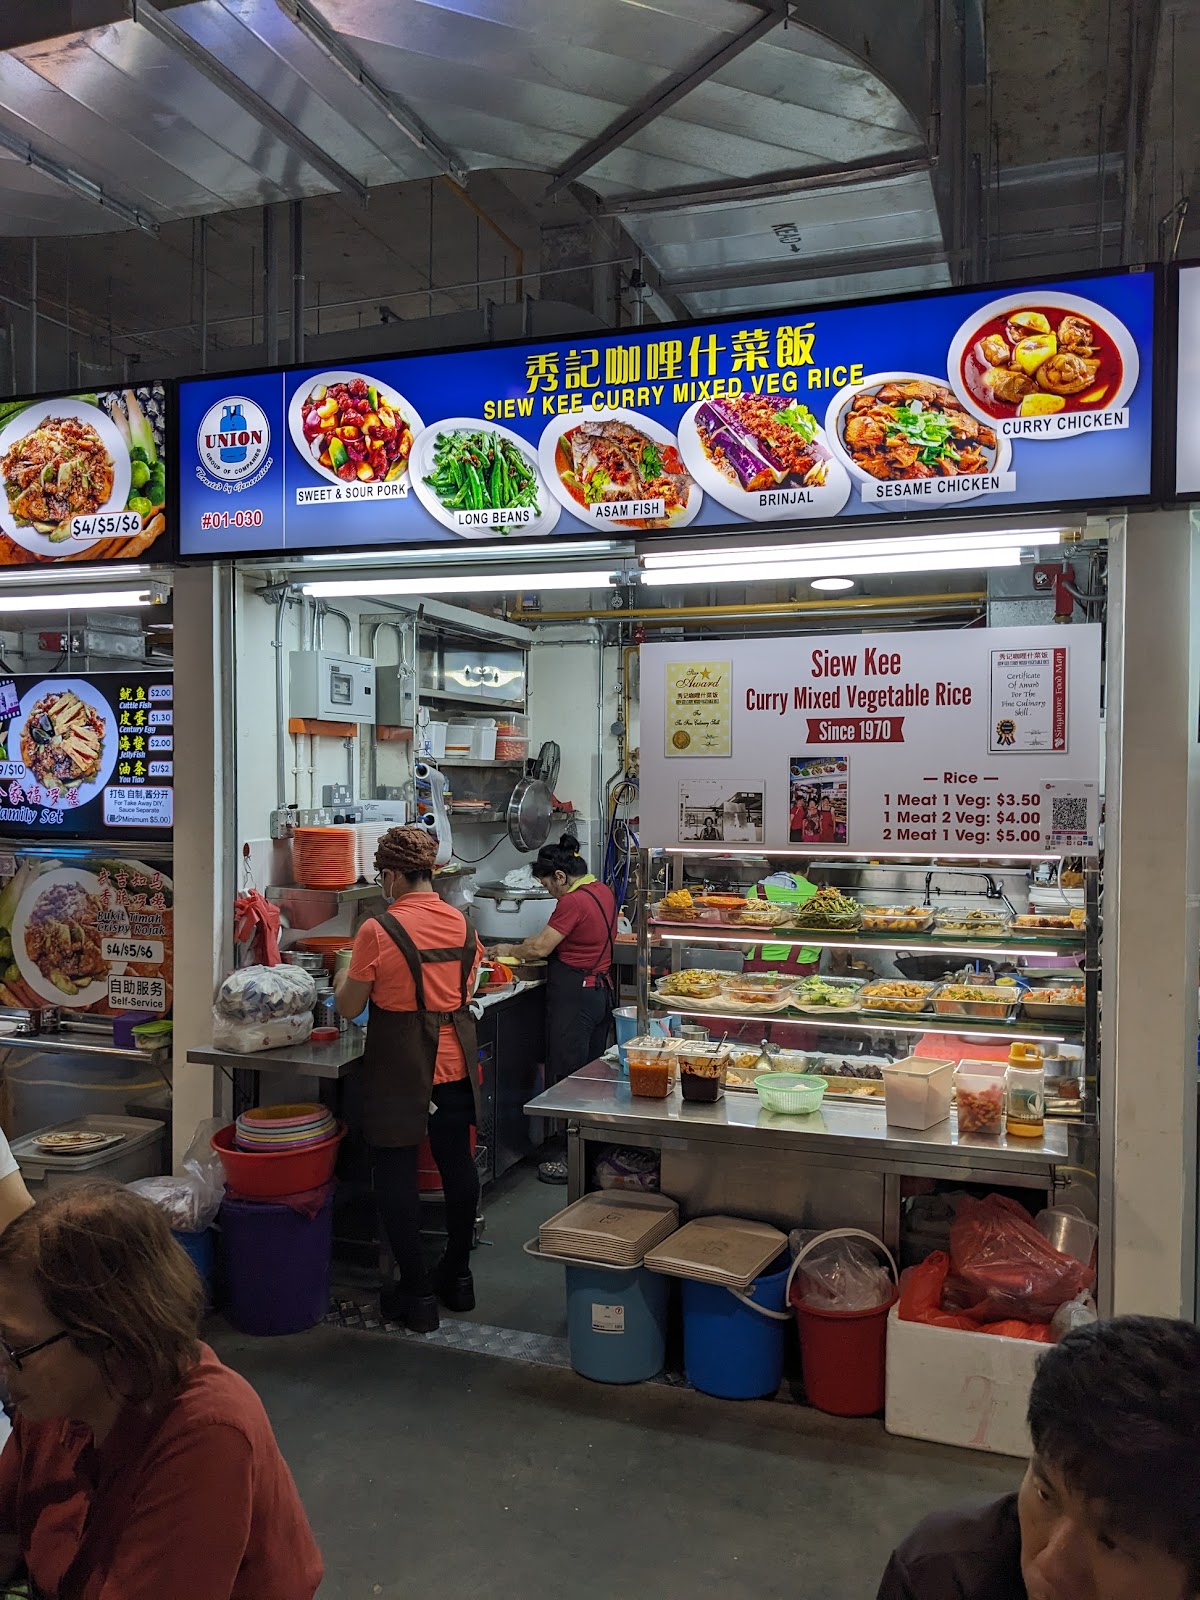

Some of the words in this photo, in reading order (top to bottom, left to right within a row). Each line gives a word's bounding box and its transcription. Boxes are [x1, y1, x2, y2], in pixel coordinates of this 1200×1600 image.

[525, 322, 816, 394] 秀記咖哩什菜飯
[484, 398, 533, 421] SIEW
[542, 394, 582, 416] KEE
[592, 386, 664, 411] CURRY
[673, 377, 743, 404] MIXED
[752, 371, 797, 395] VEG
[808, 364, 864, 388] RICE
[1002, 417, 1053, 435] CURRY
[1057, 412, 1124, 430] CHICKEN
[205, 430, 263, 449] UNION
[206, 452, 221, 470] GROUP
[234, 448, 262, 475] COMPANIES
[196, 466, 222, 491] Trusted
[223, 483, 232, 494] by
[876, 480, 932, 498] SESAME
[937, 476, 1000, 493] CHICKEN
[298, 489, 331, 502] SWEET
[335, 488, 342, 499] &
[346, 485, 374, 498] SOUR
[377, 484, 406, 496] PORK
[759, 491, 813, 506] BRINJAL
[596, 504, 629, 517] ASAM
[633, 502, 660, 516] FISH
[73, 514, 140, 536] $4/$5/$6
[202, 509, 263, 529] #01-030
[458, 512, 489, 525] LONG
[492, 511, 530, 523] BEANS
[811, 649, 857, 678] Siew
[864, 648, 901, 675] Kee
[1055, 653, 1065, 673] Map
[676, 676, 722, 688] Award
[1007, 671, 1040, 681] Certificate
[1008, 681, 1016, 690] Of
[1055, 675, 1063, 695] Food
[119, 686, 147, 701] 鱿鱼
[150, 689, 170, 698] $2.00
[746, 688, 788, 715] Curry
[794, 686, 840, 709] Mixed
[847, 683, 929, 713] Vegetable
[936, 682, 972, 706] Rice
[1024, 689, 1035, 697] The
[1016, 699, 1046, 708] Culinary
[119, 710, 147, 726] 皮蛋
[151, 714, 170, 722] $1.30
[1054, 697, 1065, 737] Singapore
[119, 726, 144, 734] Century
[144, 726, 156, 734] Egg
[818, 721, 855, 741] Since
[859, 720, 891, 740] 1970
[119, 735, 147, 751] 海蜇
[150, 739, 170, 747] $2.00
[119, 760, 147, 776] 油条
[151, 764, 169, 773] $1/$2
[943, 772, 978, 784] Rice
[110, 790, 125, 798] 打包
[884, 794, 890, 805] 1
[897, 794, 937, 805] Meat
[943, 794, 949, 805] 1
[955, 794, 990, 808] Veg:
[996, 794, 1040, 807] $3.50
[0, 806, 38, 824] amily
[39, 808, 65, 824] Set
[884, 812, 890, 823] 1
[897, 812, 937, 823] Meat
[942, 812, 951, 823] 2
[955, 812, 990, 826] Veg:
[996, 812, 1040, 825] $4.00
[883, 829, 891, 840] 2
[897, 829, 937, 840] Meat
[943, 829, 949, 840] 1
[955, 829, 990, 843] Veg:
[996, 829, 1040, 842] $5.00
[98, 868, 164, 890] 武吉知马
[97, 910, 125, 921] Bukit
[129, 912, 161, 923] Timah
[97, 922, 130, 935] Crispy
[133, 924, 166, 936] Rojak
[106, 943, 153, 958] $4/$5/$6
[110, 979, 163, 996] 自助服务
[111, 996, 163, 1008] Self-Service
